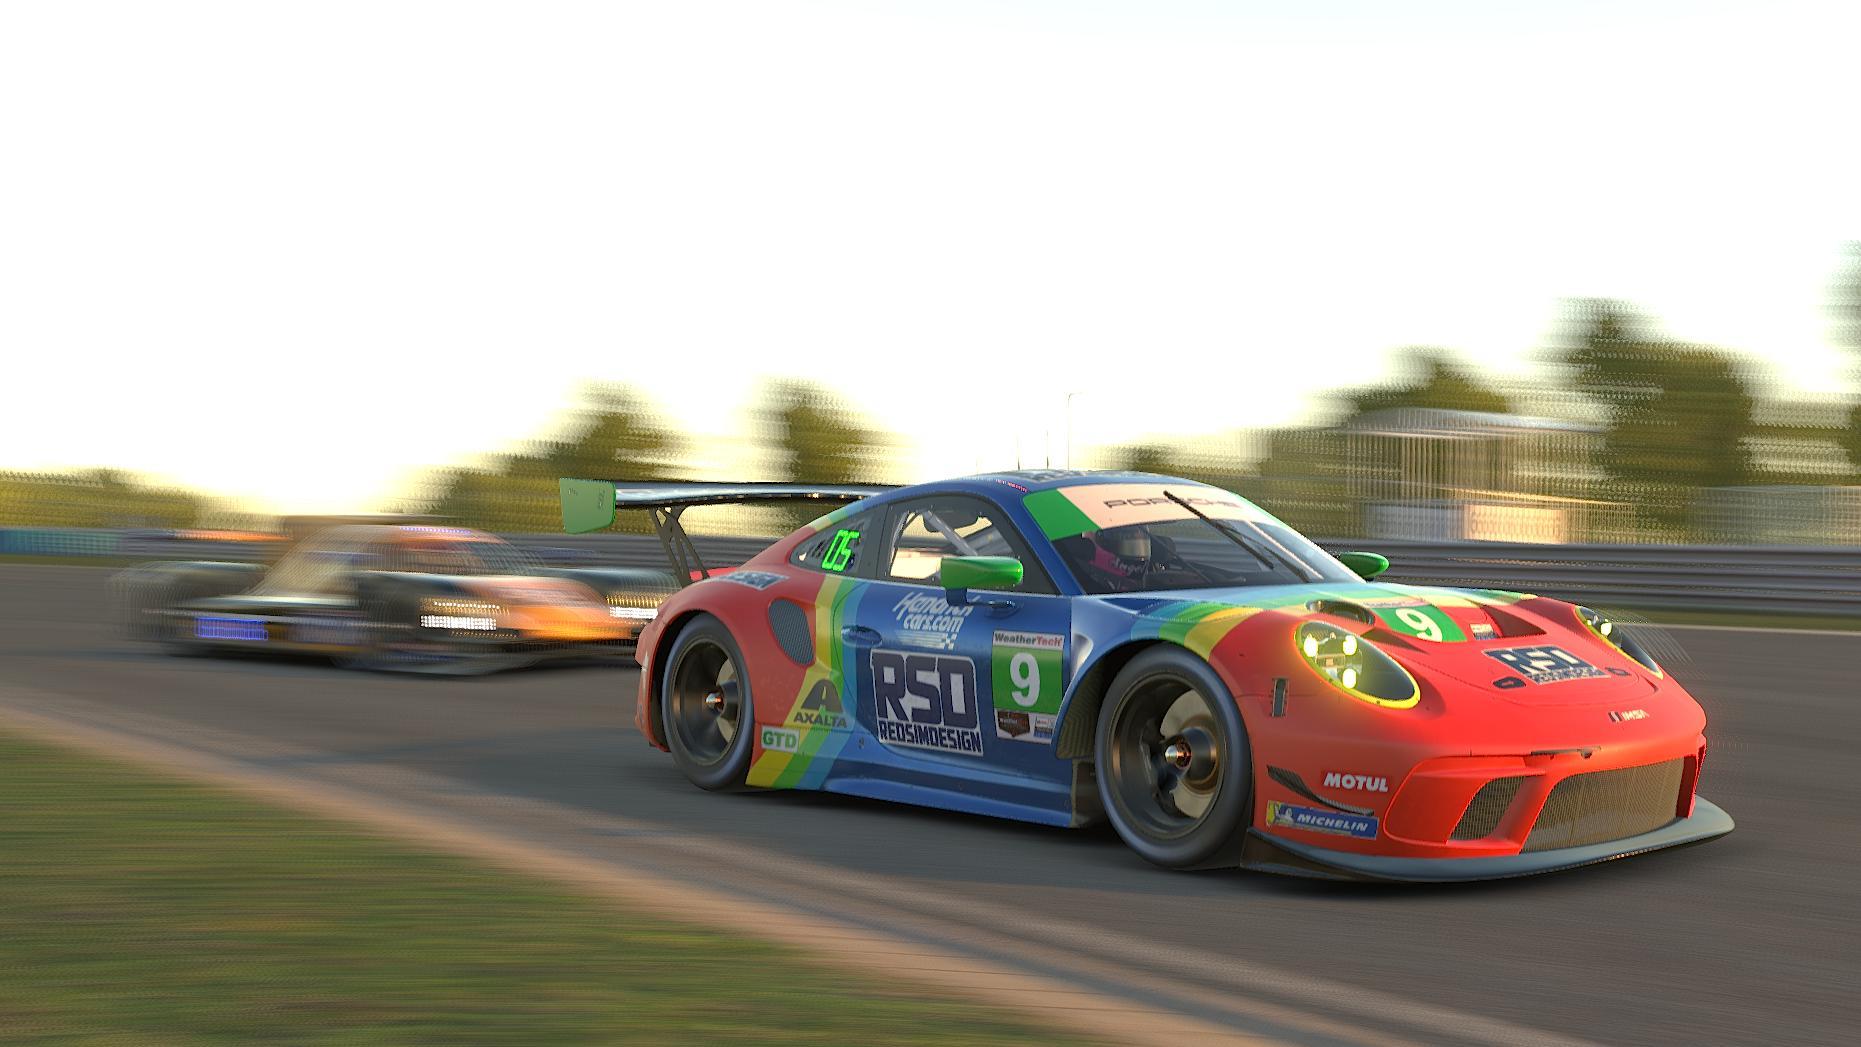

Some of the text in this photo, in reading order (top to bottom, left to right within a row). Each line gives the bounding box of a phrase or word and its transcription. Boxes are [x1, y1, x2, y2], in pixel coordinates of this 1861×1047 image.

[903, 613, 965, 633] cars.com
[1395, 608, 1443, 642] 9
[872, 651, 979, 730] RSD
[1010, 652, 1041, 708] 9
[793, 711, 848, 728] AXALTA
[762, 730, 798, 749] GTD
[879, 718, 983, 754] REDSIMDESIGN
[1323, 772, 1389, 793] MOTUL
[1297, 813, 1369, 833] MICHELIN
